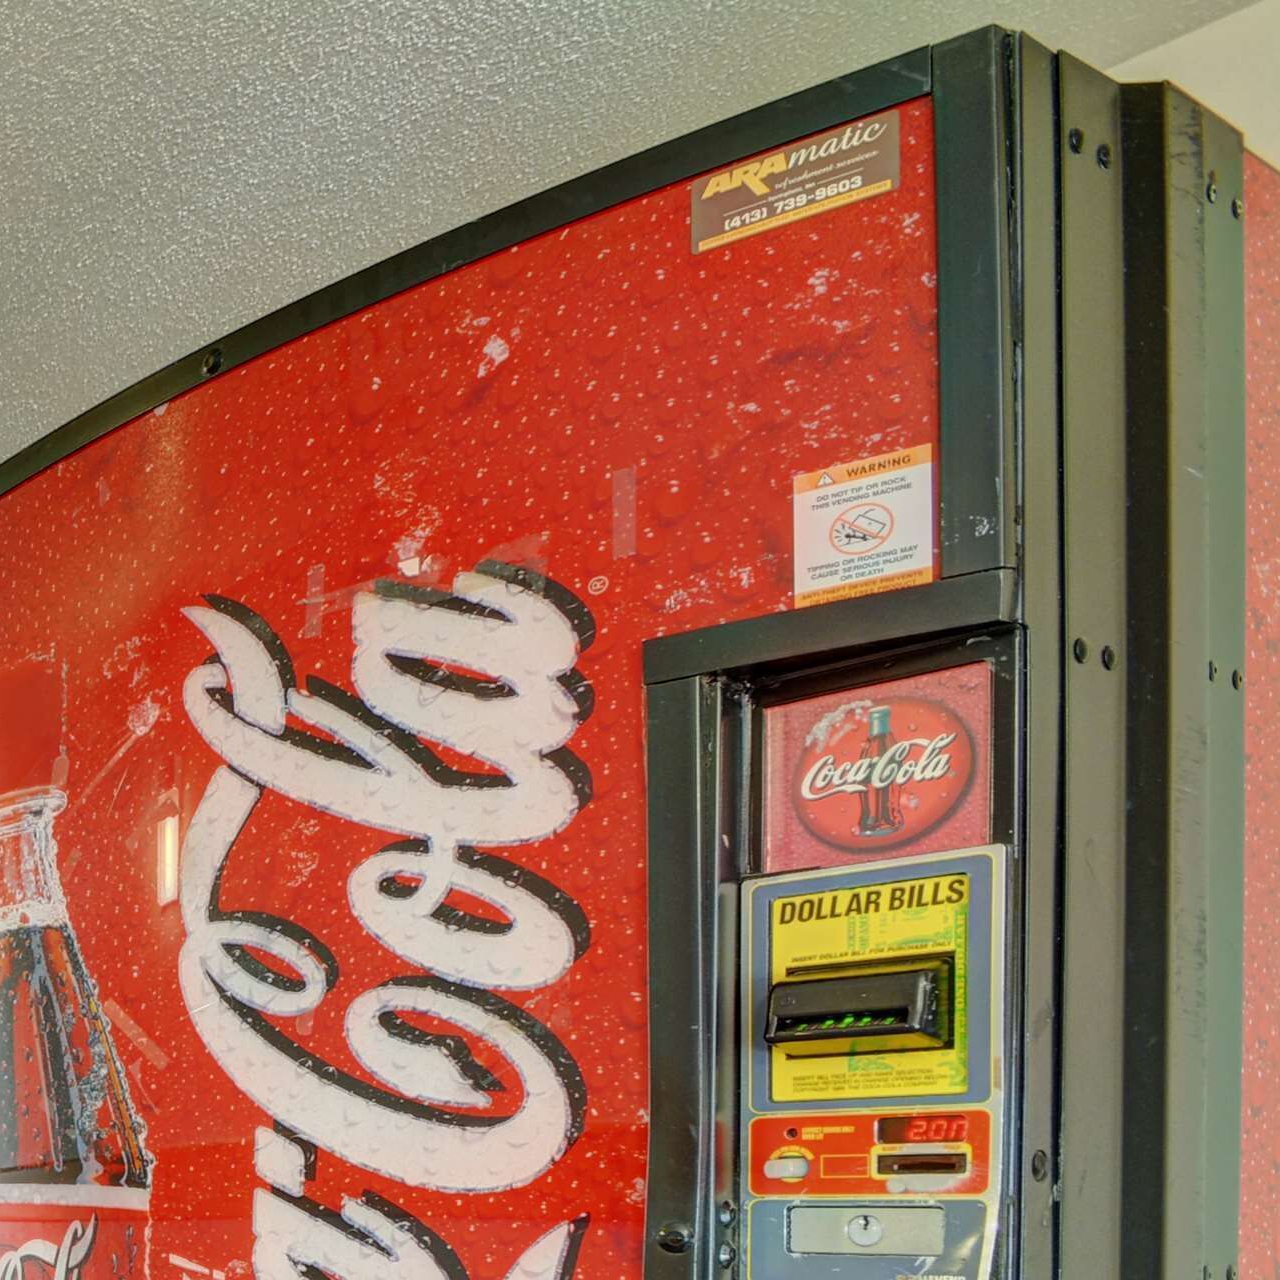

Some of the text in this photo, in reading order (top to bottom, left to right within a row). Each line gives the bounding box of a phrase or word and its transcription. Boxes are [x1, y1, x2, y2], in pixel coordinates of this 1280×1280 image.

[700, 122, 887, 200] ARAmatic
[724, 207, 768, 231] (413)
[774, 175, 862, 214] 739-9603
[846, 454, 912, 478] WARNING
[811, 482, 913, 511] THIS VENDING MACHINE
[816, 476, 906, 503] DO NOT TIP OR ROCK
[807, 544, 918, 573] TIPPING OR ROCKING MAY
[811, 553, 914, 580] CAUSE SERIOUS INJURY
[841, 567, 885, 582] OR DEATH
[801, 733, 957, 800] Coca-Cola
[779, 879, 965, 925] DOLLAR BILLS
